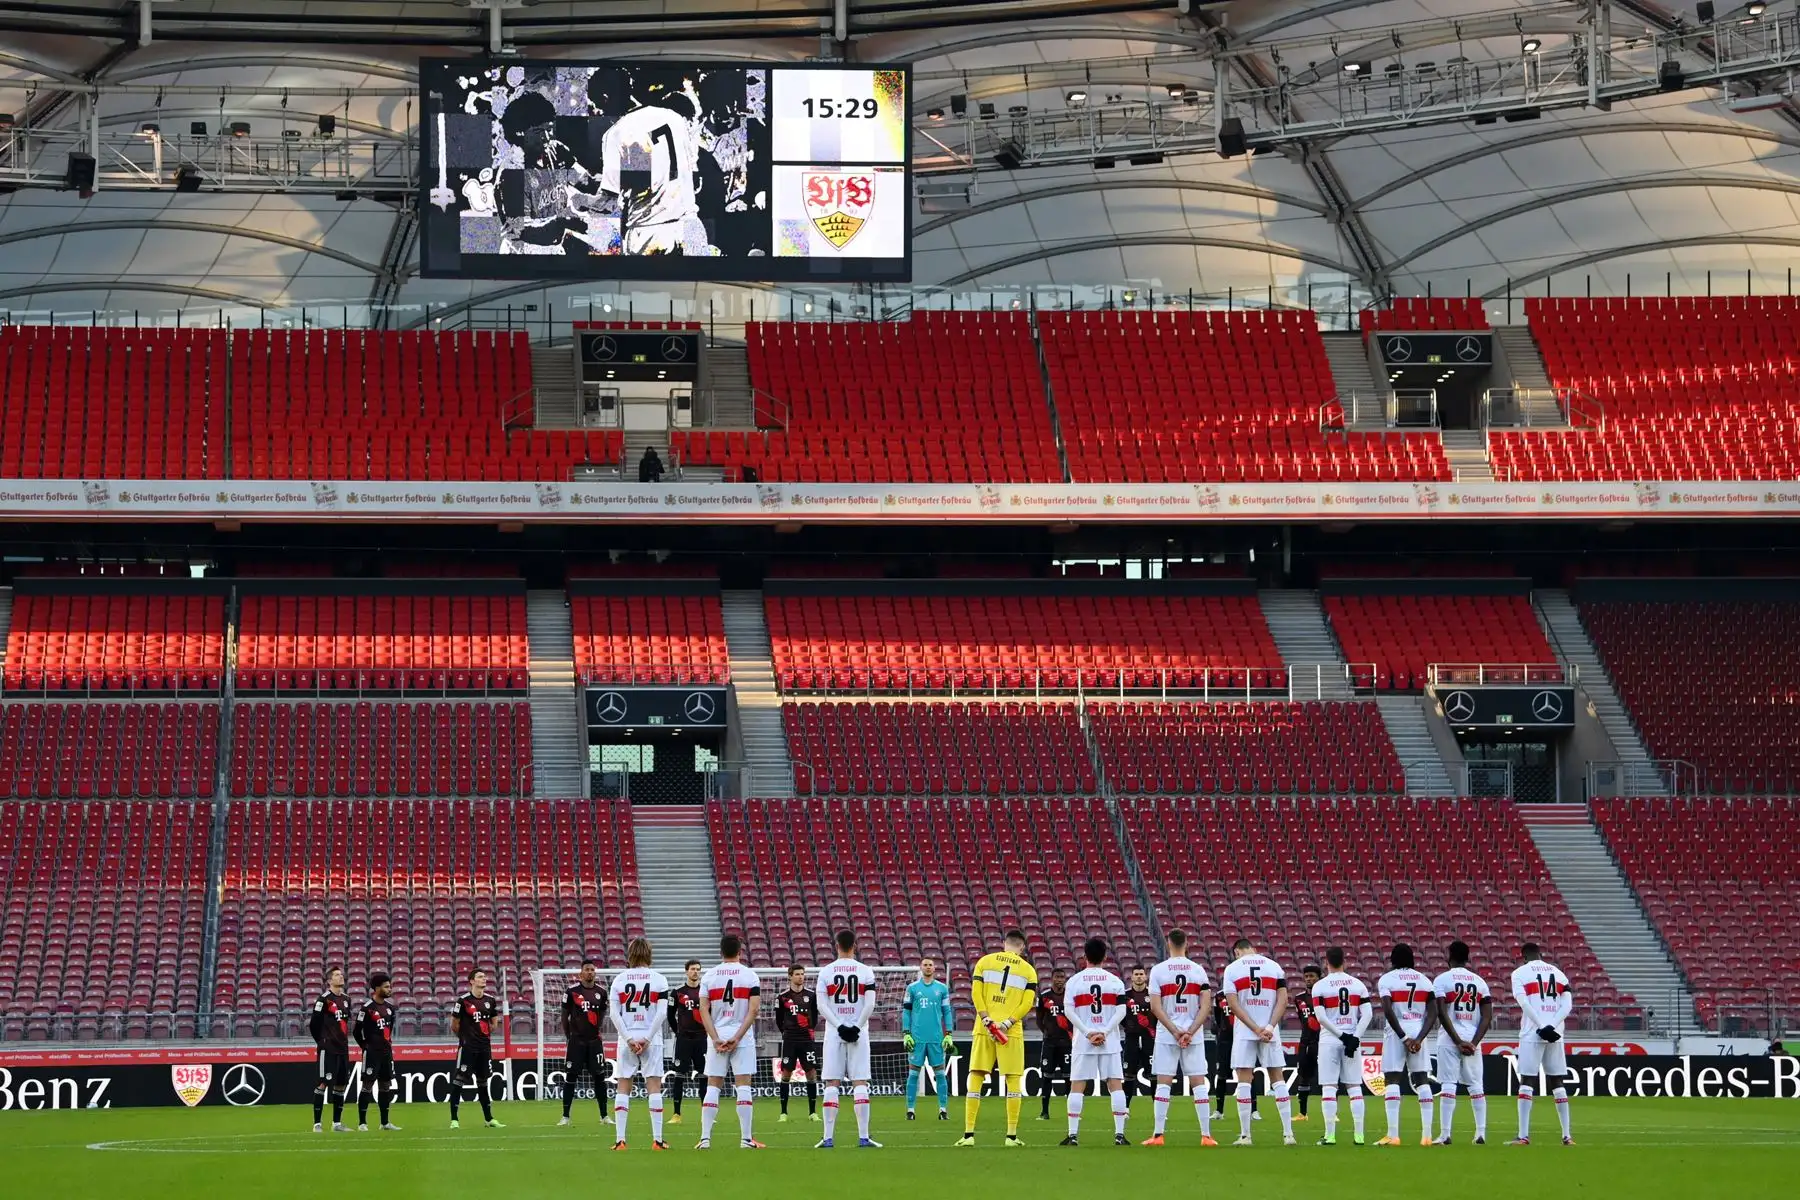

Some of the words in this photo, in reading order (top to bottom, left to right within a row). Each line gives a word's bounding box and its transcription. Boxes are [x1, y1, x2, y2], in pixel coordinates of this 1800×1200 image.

[802, 98, 878, 119] 15:29
[651, 123, 678, 181] 7
[807, 176, 872, 208] VfB
[0, 492, 43, 502] Stuttgarter
[133, 493, 177, 503] Stuttgarter
[230, 493, 274, 503] Stuttgarter
[361, 493, 403, 503] Stuttgarter
[456, 494, 498, 504] Stuttgarter
[584, 494, 626, 504] Stuttgarter
[678, 495, 720, 505] Stuttgarter
[804, 495, 846, 505] Stuttgarter
[897, 495, 939, 505] Stuttgarter
[1023, 496, 1065, 506] Stuttgarter
[1116, 496, 1158, 506] Stuttgarter
[1242, 495, 1283, 505] Stuttgarter
[1335, 495, 1377, 505] Stuttgarter
[1462, 494, 1504, 504] Stuttgarter
[1555, 494, 1597, 504] Stuttgarter
[1683, 493, 1725, 503] Stuttgarter
[996, 955, 1021, 965] STUTTGART
[1001, 965, 1010, 993] 1
[1250, 966, 1260, 996] 5
[723, 979, 734, 1007] 4
[834, 975, 858, 1004] 20
[1175, 974, 1187, 1004] 2
[1536, 974, 1557, 1002] 14
[625, 983, 650, 1012] 24
[1090, 984, 1102, 1014] 3
[1339, 987, 1350, 1016] 8
[1406, 983, 1416, 1010] 7
[1454, 983, 1477, 1012] 23
[806, 1051, 815, 1061] 25
[176, 1067, 208, 1085] VfB
